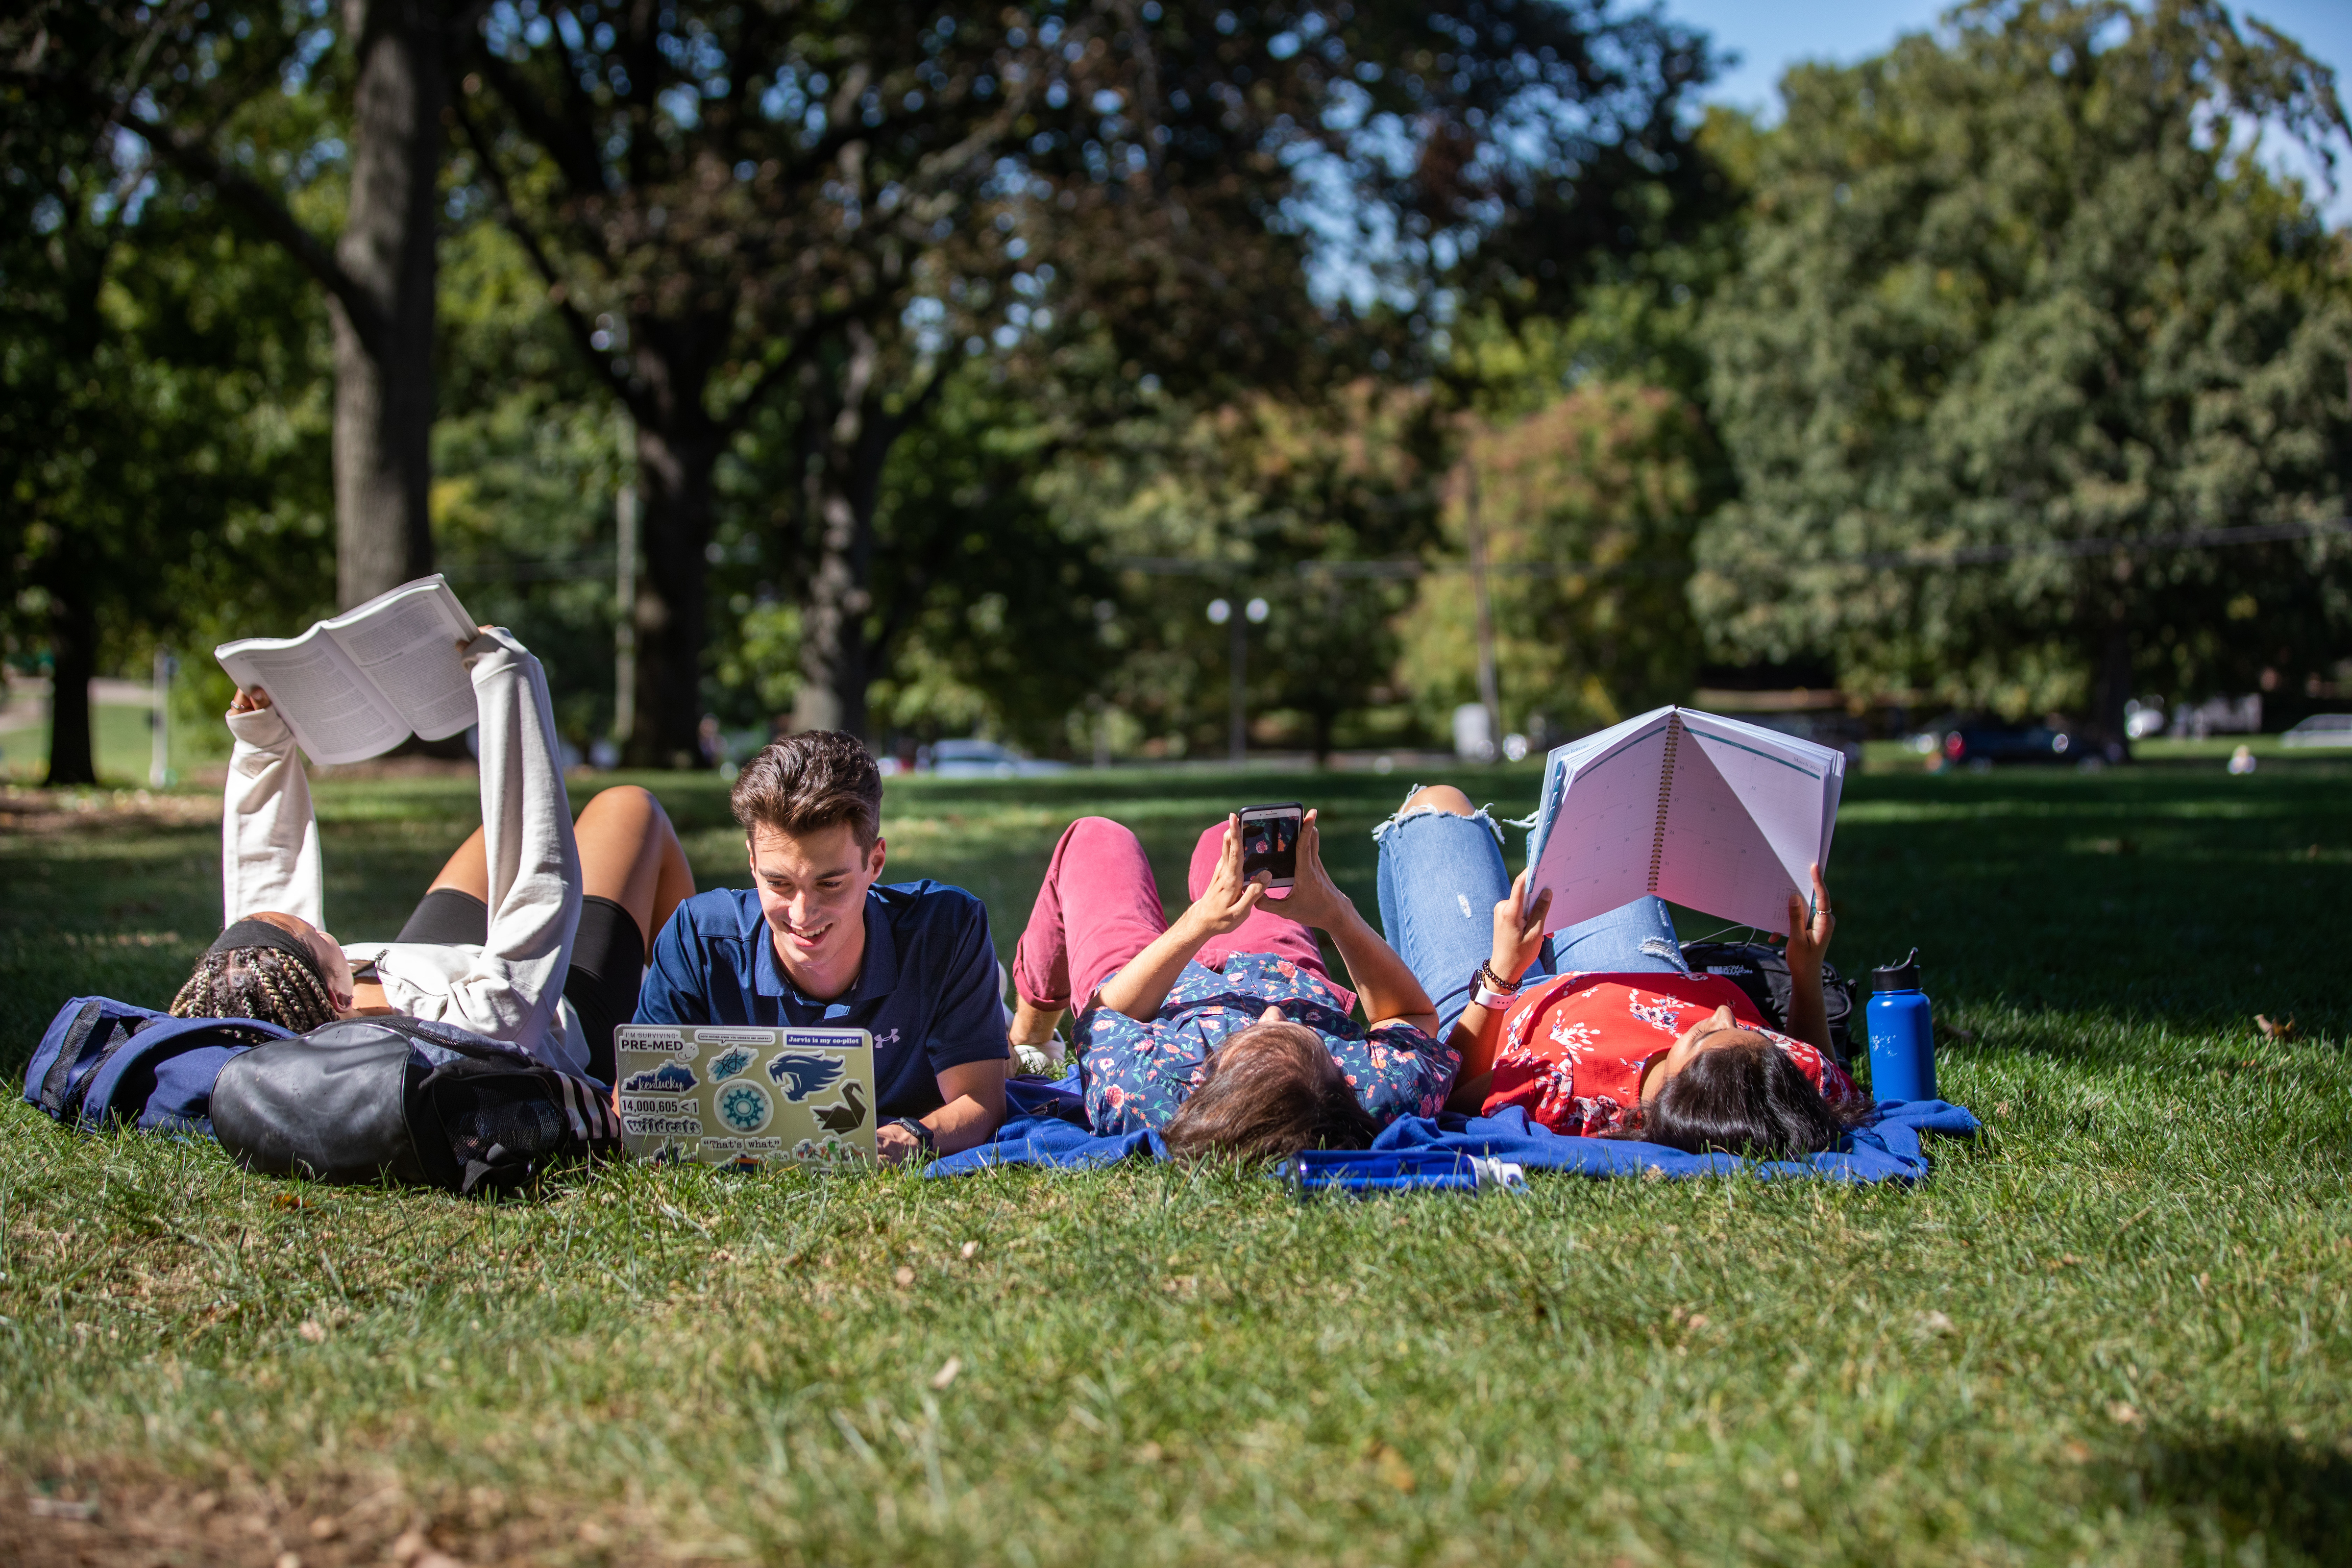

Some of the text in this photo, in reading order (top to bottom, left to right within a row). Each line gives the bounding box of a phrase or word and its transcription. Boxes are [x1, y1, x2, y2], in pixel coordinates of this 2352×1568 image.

[1570, 744, 1589, 754] Reference
[1763, 753, 1778, 762] Saturday
[1793, 757, 1821, 772] March 2022
[621, 1039, 683, 1051] PRE-MED
[638, 1075, 685, 1093] kentucky
[719, 1088, 729, 1101] PROOF
[759, 1092, 768, 1105] STARK
[622, 1100, 678, 1113] 14,000,605
[693, 1102, 697, 1113] 1
[627, 1118, 701, 1134] wildcats
